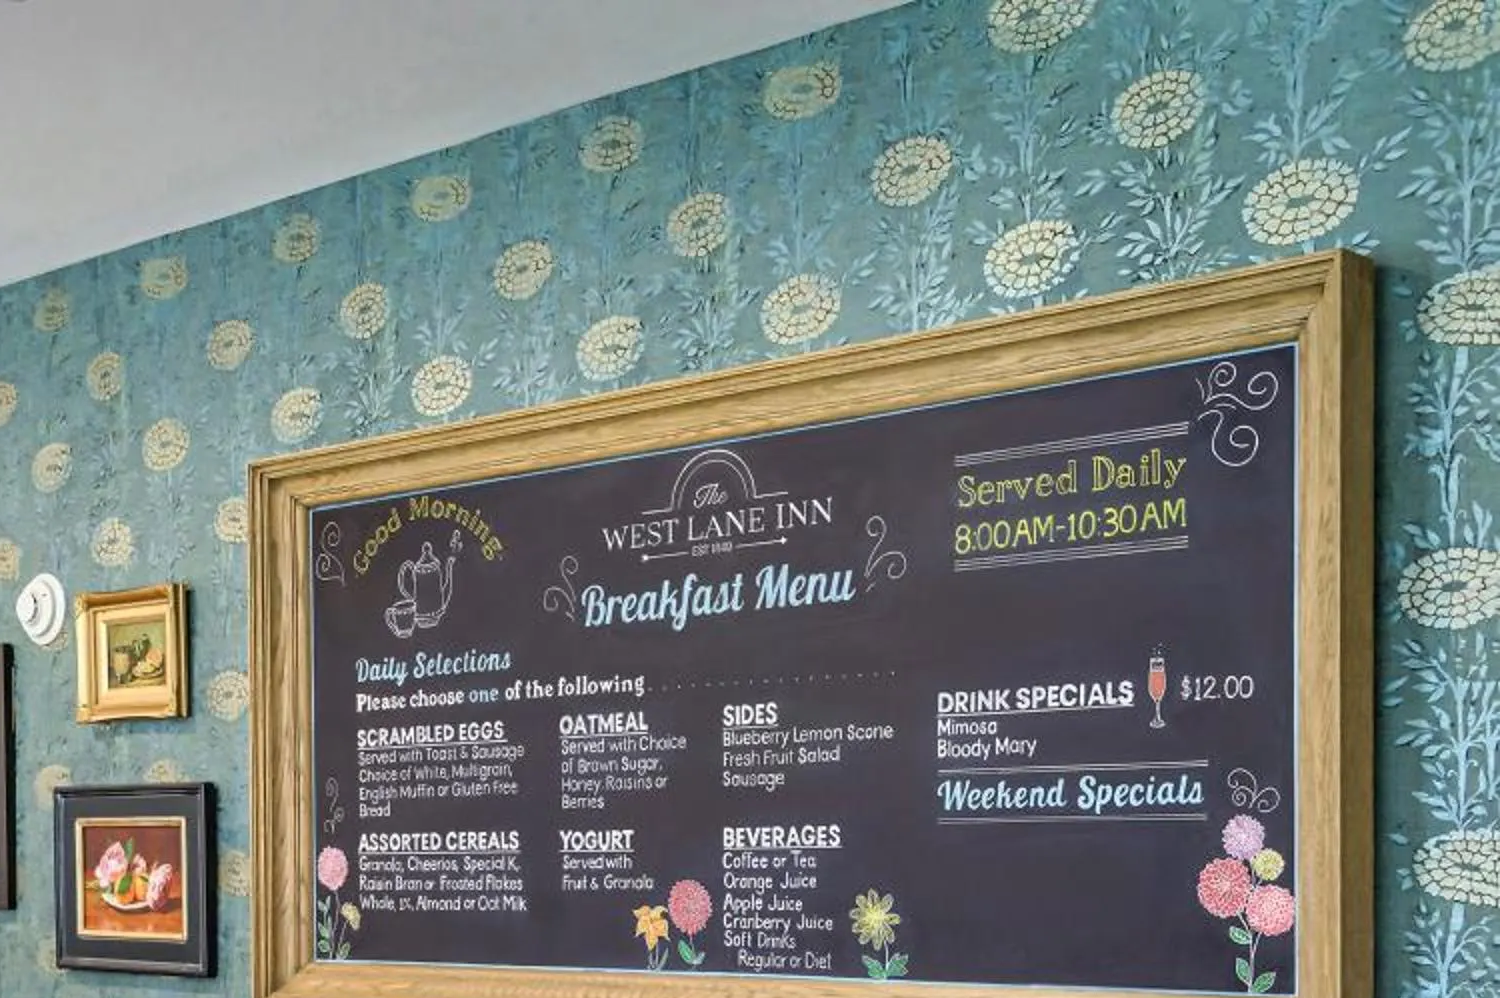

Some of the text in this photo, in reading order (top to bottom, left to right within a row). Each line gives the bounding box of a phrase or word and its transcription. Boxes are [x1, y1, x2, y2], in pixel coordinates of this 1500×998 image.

[957, 448, 1188, 507] Served Daily
[693, 483, 728, 509] The
[602, 519, 680, 551] WEST
[687, 508, 766, 541] LANE
[776, 497, 833, 529] INN
[353, 496, 504, 576] Good Morning
[581, 564, 857, 631] Breakfast Menu
[356, 649, 511, 687] Daily Selections
[356, 675, 645, 713] Please choose one of the following
[938, 680, 1134, 713] DRINK SPECIALS
[1180, 675, 1254, 701] $12.00
[559, 711, 649, 735] OATMEAL
[723, 701, 778, 726] SIDES
[357, 720, 505, 747] SCRAMBLED EGGS
[723, 724, 894, 749] Blueberry Lemon Scone
[938, 718, 997, 736] Mimosa
[357, 744, 525, 766] Served with Toast & Sausage
[561, 734, 687, 755] Served with Choice
[938, 737, 1037, 761] Bloody Mary
[561, 757, 573, 774] of
[577, 758, 618, 774] Brown
[723, 745, 841, 767] Fresh Fruit Salad
[358, 767, 399, 783] Choice
[400, 765, 412, 780] of
[605, 775, 652, 791] Raisins
[654, 776, 668, 789] or
[723, 771, 785, 792] Sausage
[359, 784, 398, 804] English
[400, 783, 435, 799] Muffin
[437, 786, 449, 797] or
[451, 781, 491, 797] Gluten
[561, 794, 605, 809] Berries
[937, 775, 1205, 815] Weekend Specials
[359, 801, 391, 817] Bread
[358, 830, 519, 851] ASSORTED CEREALS
[559, 829, 634, 850] YOGURT
[723, 824, 841, 847] BEVERAGES
[463, 855, 505, 874] Special
[562, 854, 633, 869] Served with
[722, 850, 817, 869] Coffee or Tea
[359, 873, 523, 891] Raisin Bran or Frosted Flakes
[562, 873, 654, 890] Fruit & Granola
[723, 872, 817, 894] Orange Juice
[416, 895, 461, 911] Almond
[463, 899, 476, 910] or
[477, 896, 500, 911] Oat
[503, 895, 527, 911] Milk
[723, 893, 803, 914] Apple Juice
[723, 913, 833, 932] Cranberry Juice
[723, 930, 796, 949] Soft Drinks
[737, 949, 832, 971] Regular or Diet
